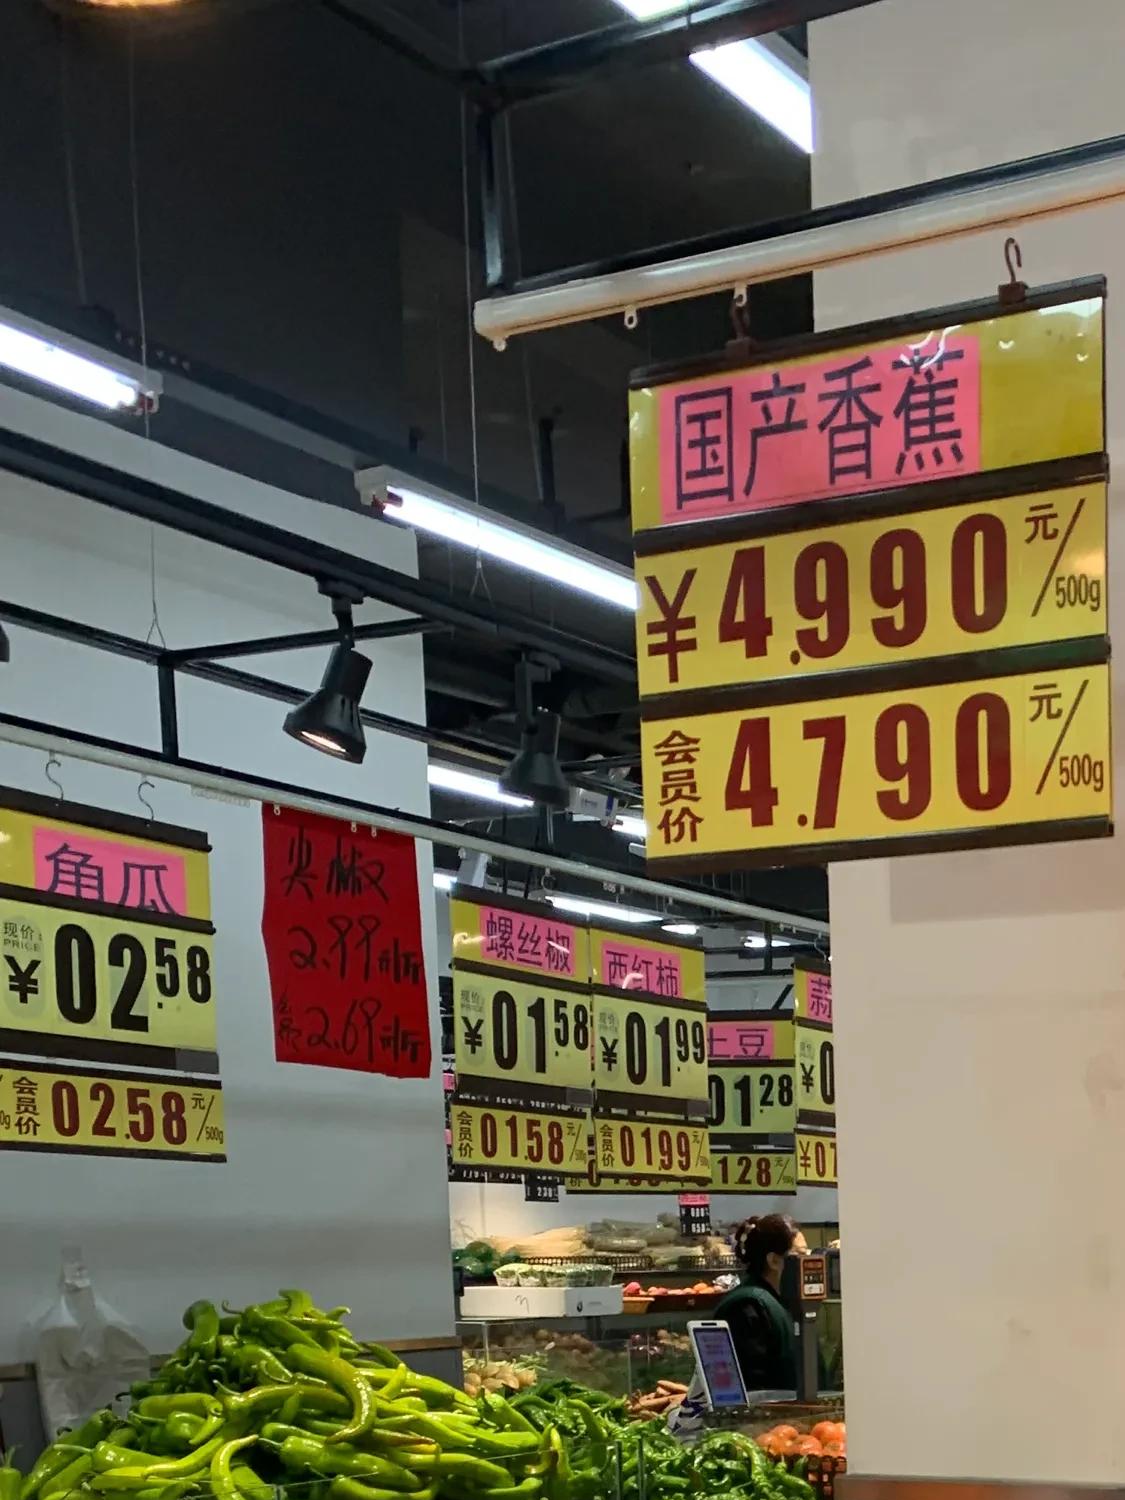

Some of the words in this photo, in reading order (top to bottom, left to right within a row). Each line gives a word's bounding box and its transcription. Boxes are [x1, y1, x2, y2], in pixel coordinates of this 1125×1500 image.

[675, 346, 965, 510] 国产香蕉
[653, 730, 704, 844] 会员价
[724, 692, 1012, 829] 4.790
[44, 843, 178, 915] 角瓜
[486, 913, 572, 974] 螺丝椒
[606, 950, 679, 997] 西红柿
[707, 1026, 770, 1059] 土豆
[12, 1077, 40, 1135] 会员价
[457, 1110, 474, 1158] 会员价
[600, 1123, 614, 1168] 会员价
